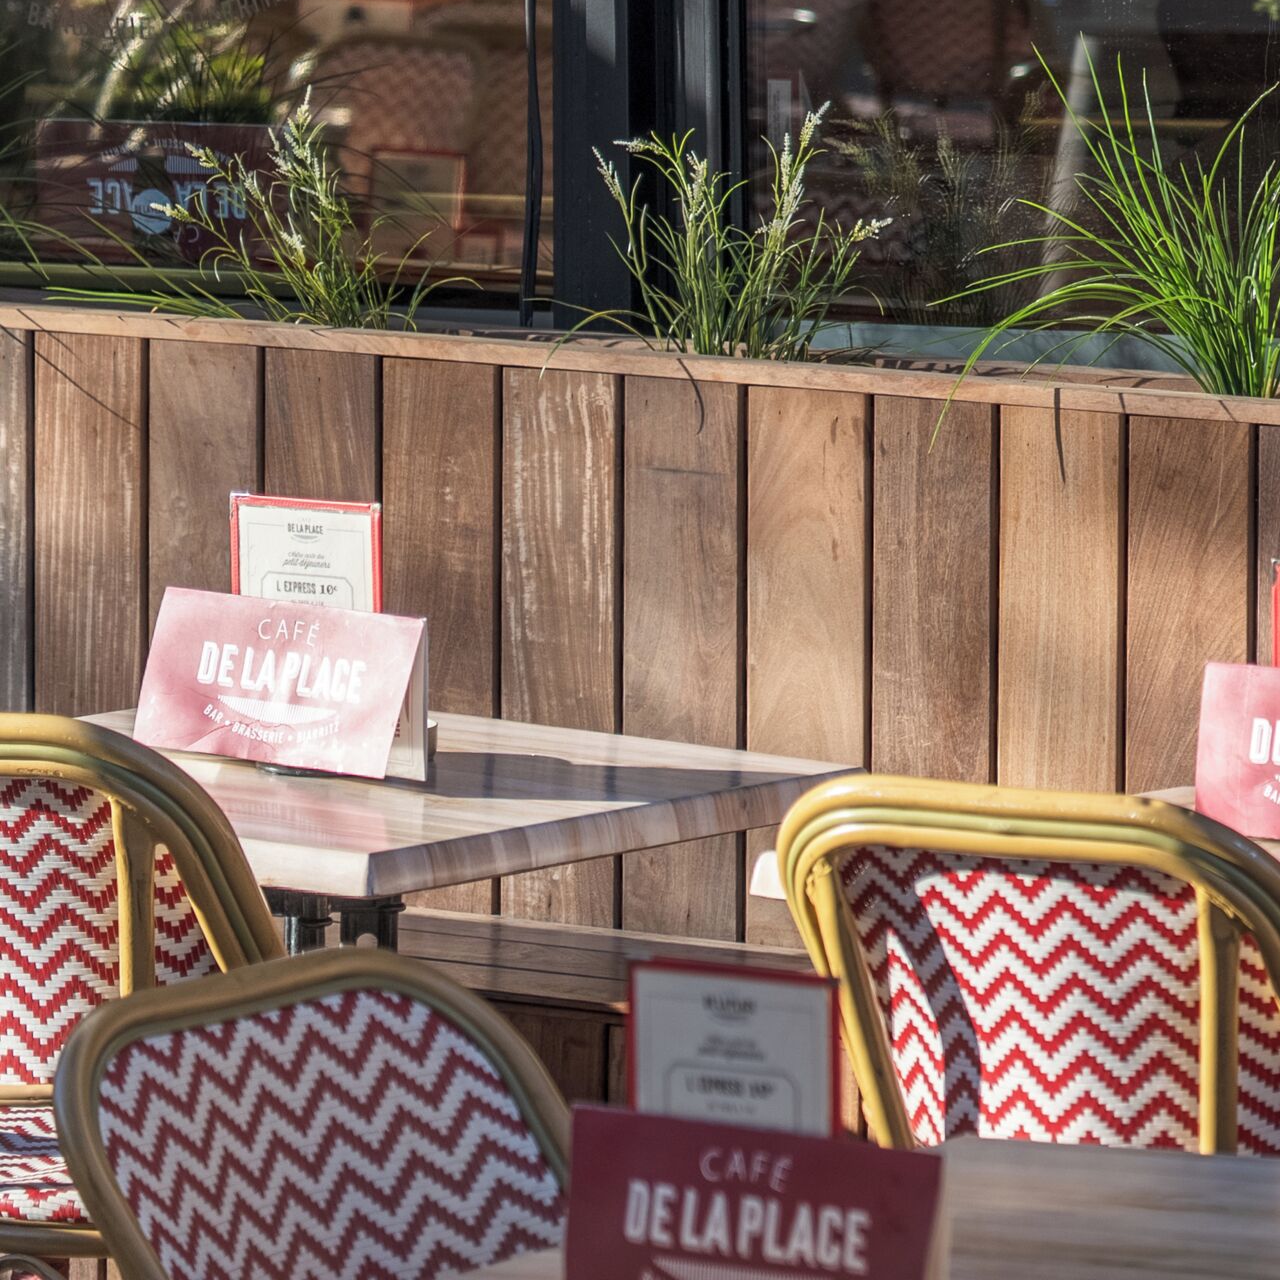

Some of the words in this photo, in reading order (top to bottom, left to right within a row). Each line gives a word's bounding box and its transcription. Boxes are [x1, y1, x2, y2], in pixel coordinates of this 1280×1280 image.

[283, 580, 317, 595] EXPRESS
[258, 619, 320, 648] CAFÉ
[197, 641, 239, 688] DE
[240, 646, 276, 693] LA
[277, 651, 367, 705] PLACE
[203, 703, 224, 726] BAR
[231, 720, 284, 745] BRASSERIE
[699, 1146, 794, 1193] CAFÉ
[623, 1179, 678, 1247] DE
[680, 1184, 732, 1259] LA
[737, 1193, 871, 1275] PLACE
